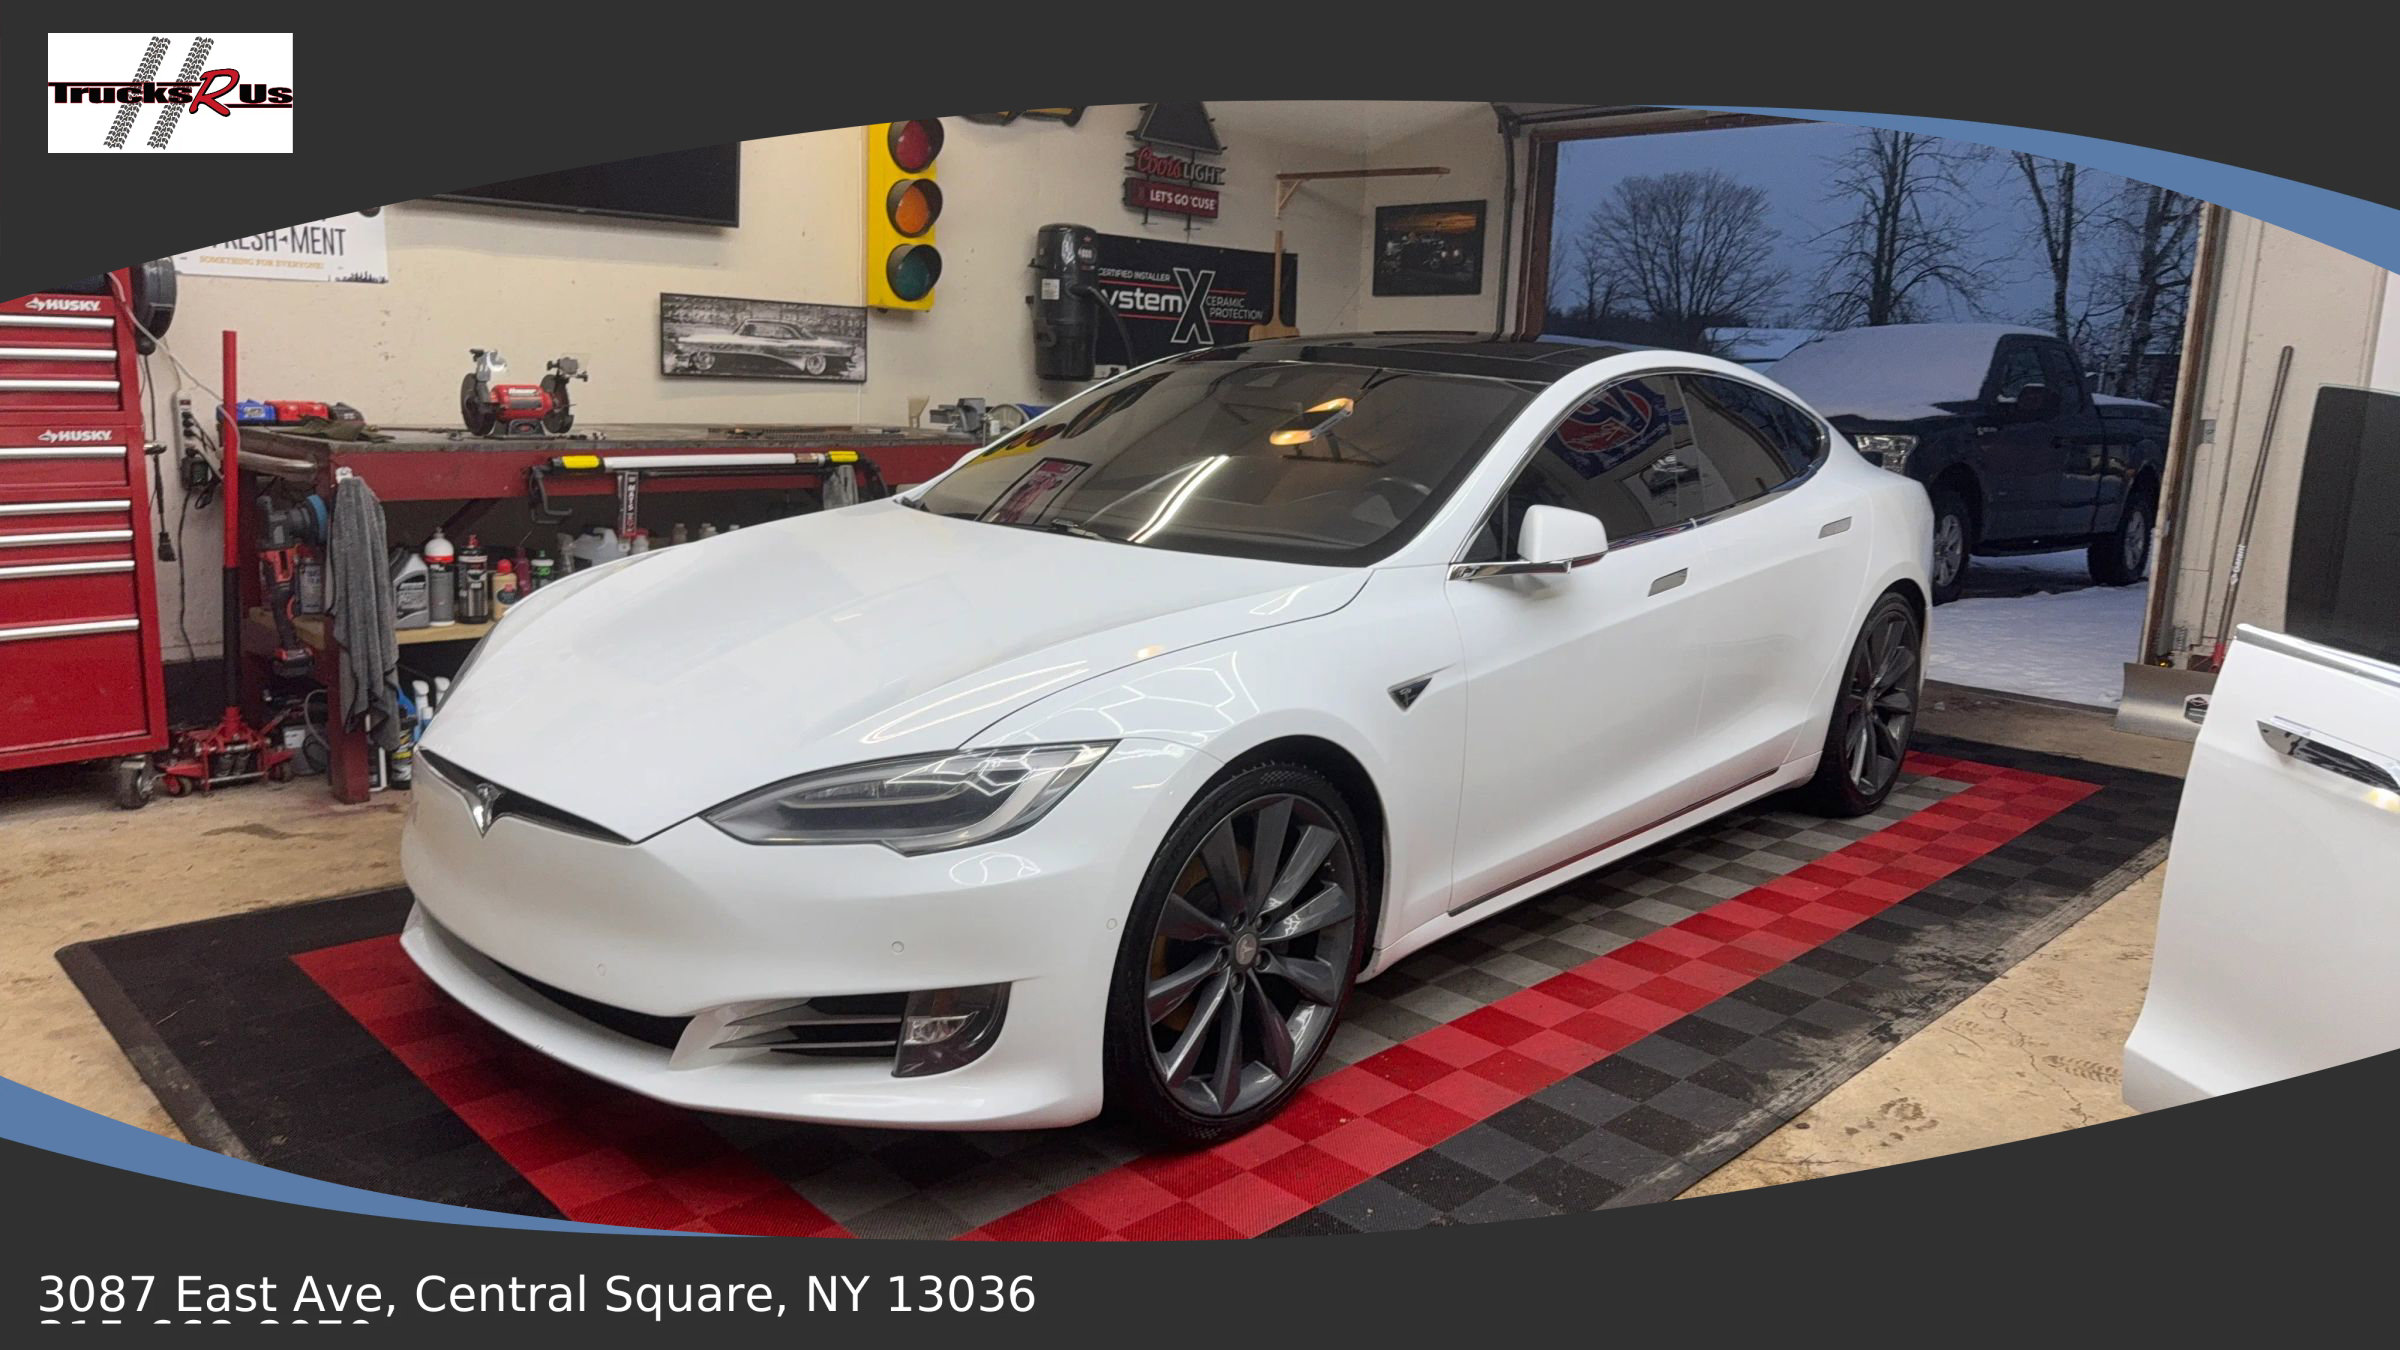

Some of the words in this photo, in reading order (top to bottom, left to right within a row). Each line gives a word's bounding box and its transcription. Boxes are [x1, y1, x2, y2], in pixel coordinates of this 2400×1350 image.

[1183, 161, 1225, 184] LIGHT
[1150, 188, 1173, 204] LET'S
[1174, 193, 1189, 206] GO
[255, 258, 274, 267] FOR
[1133, 271, 1171, 282] INSTALLER
[45, 299, 101, 312] HUSKY
[1100, 287, 1183, 313] ystem
[1205, 295, 1245, 308] CERAMIC
[1209, 306, 1263, 321] PROTECTION
[56, 430, 113, 442] HUSKY
